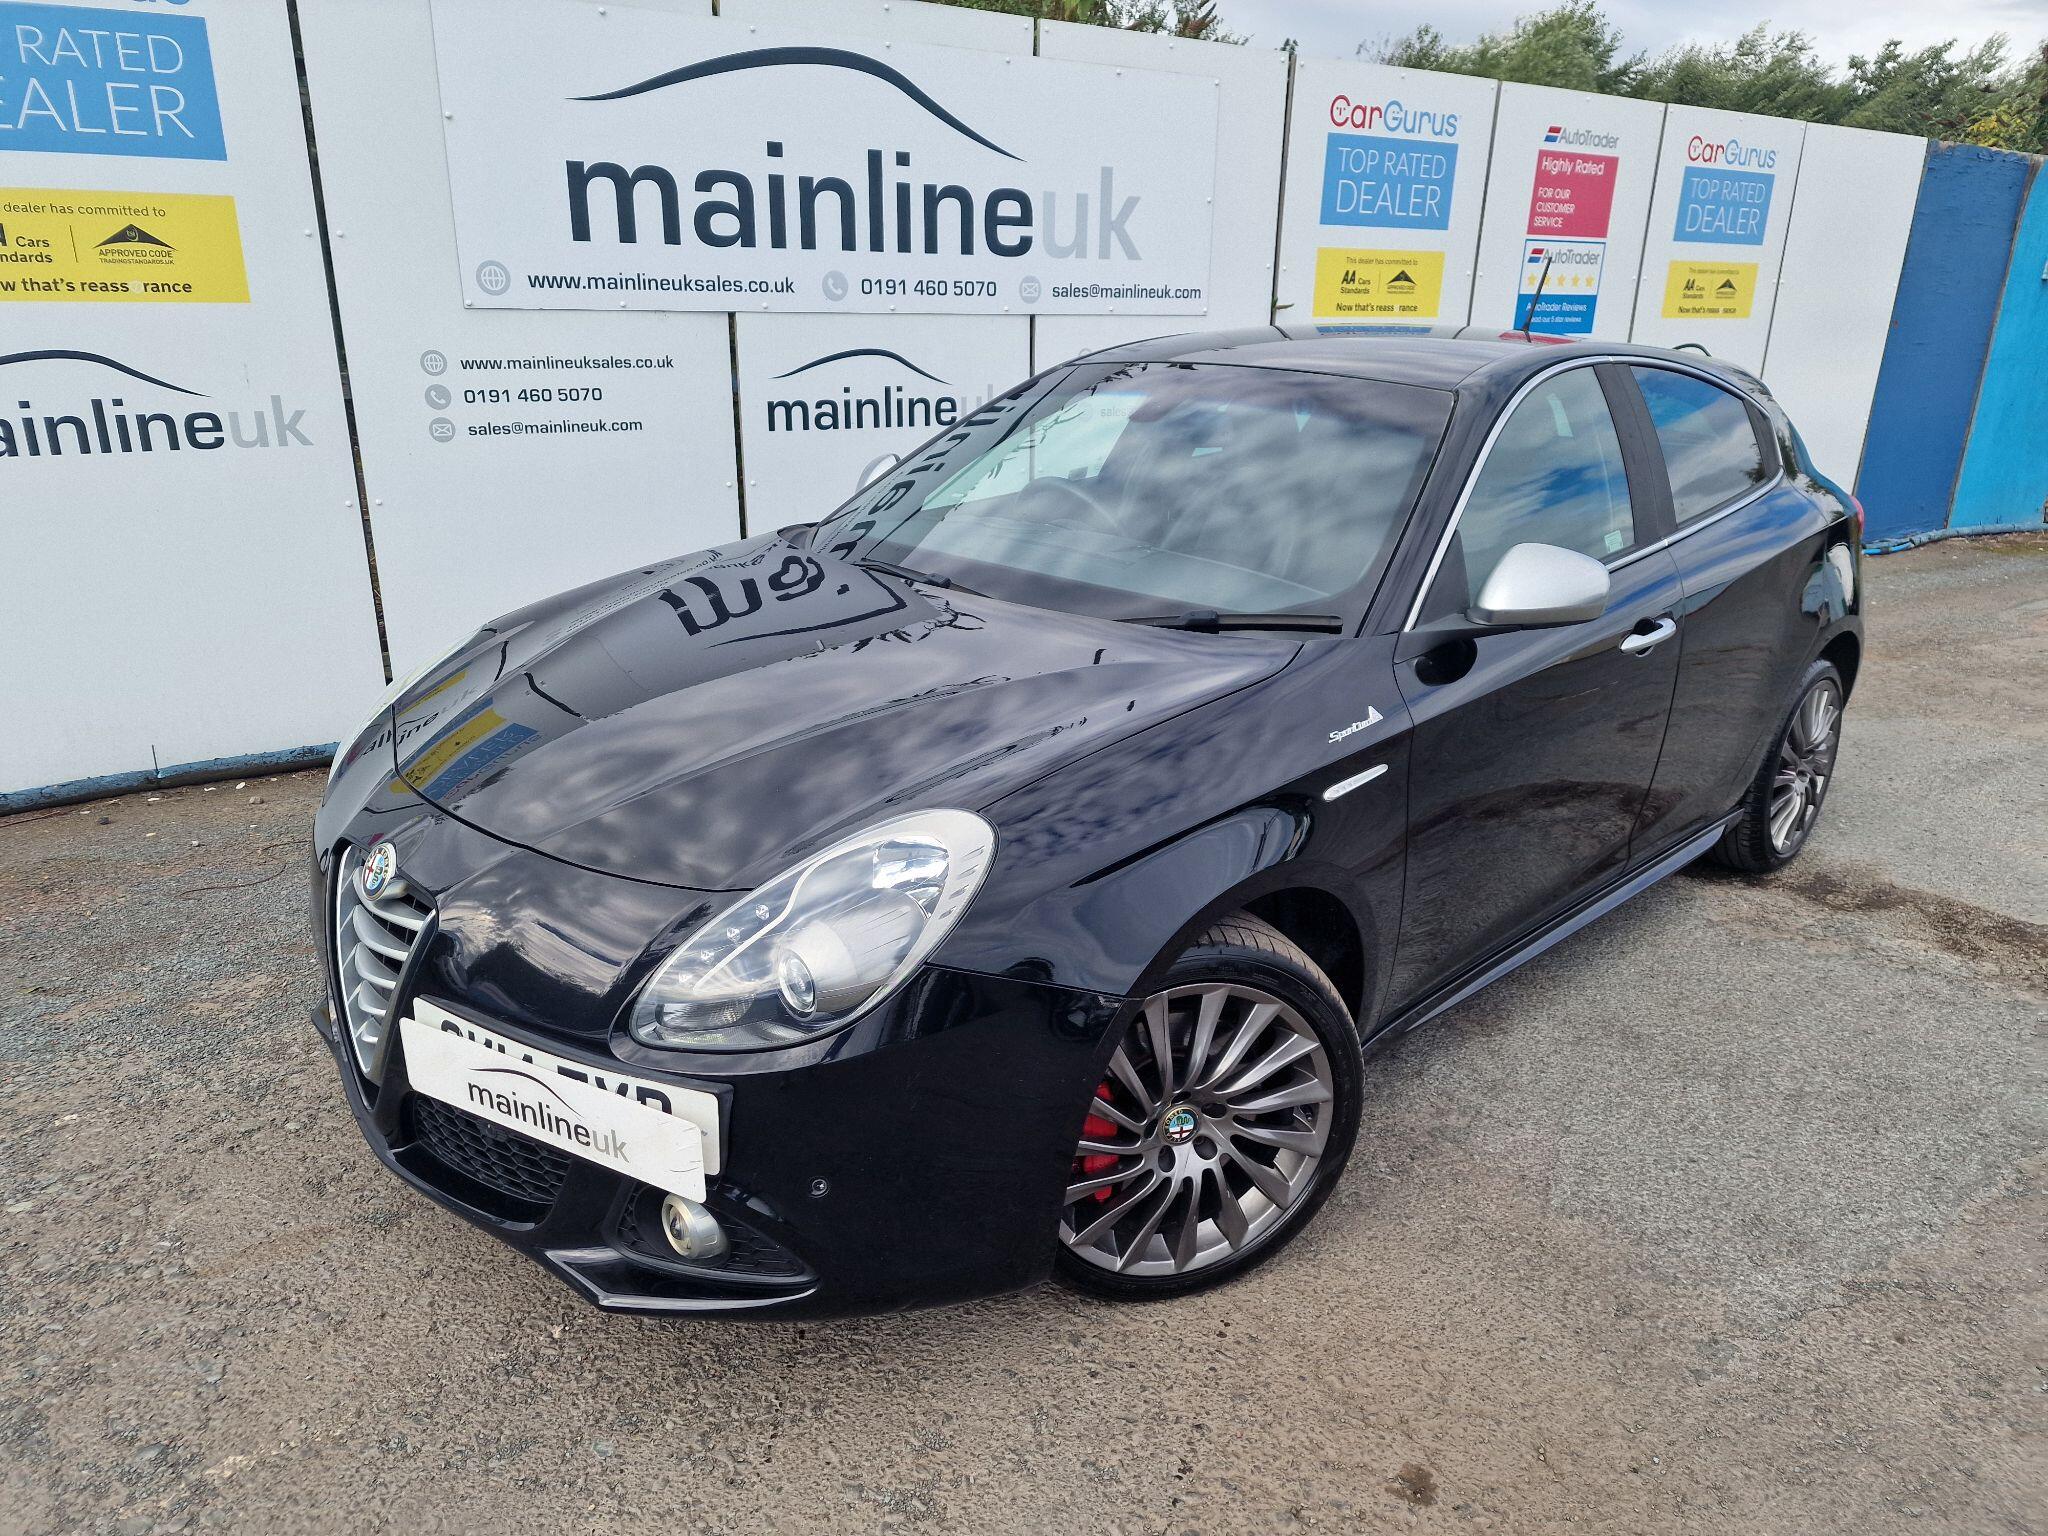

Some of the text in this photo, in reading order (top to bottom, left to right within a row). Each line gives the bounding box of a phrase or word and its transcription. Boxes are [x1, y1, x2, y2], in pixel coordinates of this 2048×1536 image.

[15, 24, 184, 75] RATED
[0, 75, 195, 138] ALER
[1330, 94, 1458, 137] CarGurus
[1558, 127, 1620, 149] AutoTrader
[1687, 135, 1776, 169] CarGurus
[1338, 147, 1446, 179] TOP RATED
[1541, 156, 1605, 175] Highly Rated
[1336, 179, 1441, 218] DEALER
[1538, 187, 1571, 199] FOR OUR
[1690, 177, 1766, 204] TOP RATED
[3, 202, 166, 217] dealer has committed to
[566, 140, 1143, 261] mainlineuk
[1536, 202, 1575, 214] CUSTOMER
[1533, 215, 1563, 228] SERVICE
[1685, 204, 1760, 236] DEALER
[15, 236, 50, 248] Cars
[99, 248, 173, 258] APPROVED CODE
[528, 272, 795, 294] www.mainlineuksales.co.uk
[1341, 269, 1356, 285] AA
[861, 278, 997, 297] 0191 460 5070
[1052, 283, 1202, 300] sales@mainlineuk.com
[1336, 302, 1353, 312] Now
[460, 355, 675, 370] www.mainlineuksales.co.uk
[464, 387, 603, 404] 0191 460 5070
[468, 418, 643, 436] sales@mainlineuk.com
[467, 1080, 630, 1164] mainlineuk
